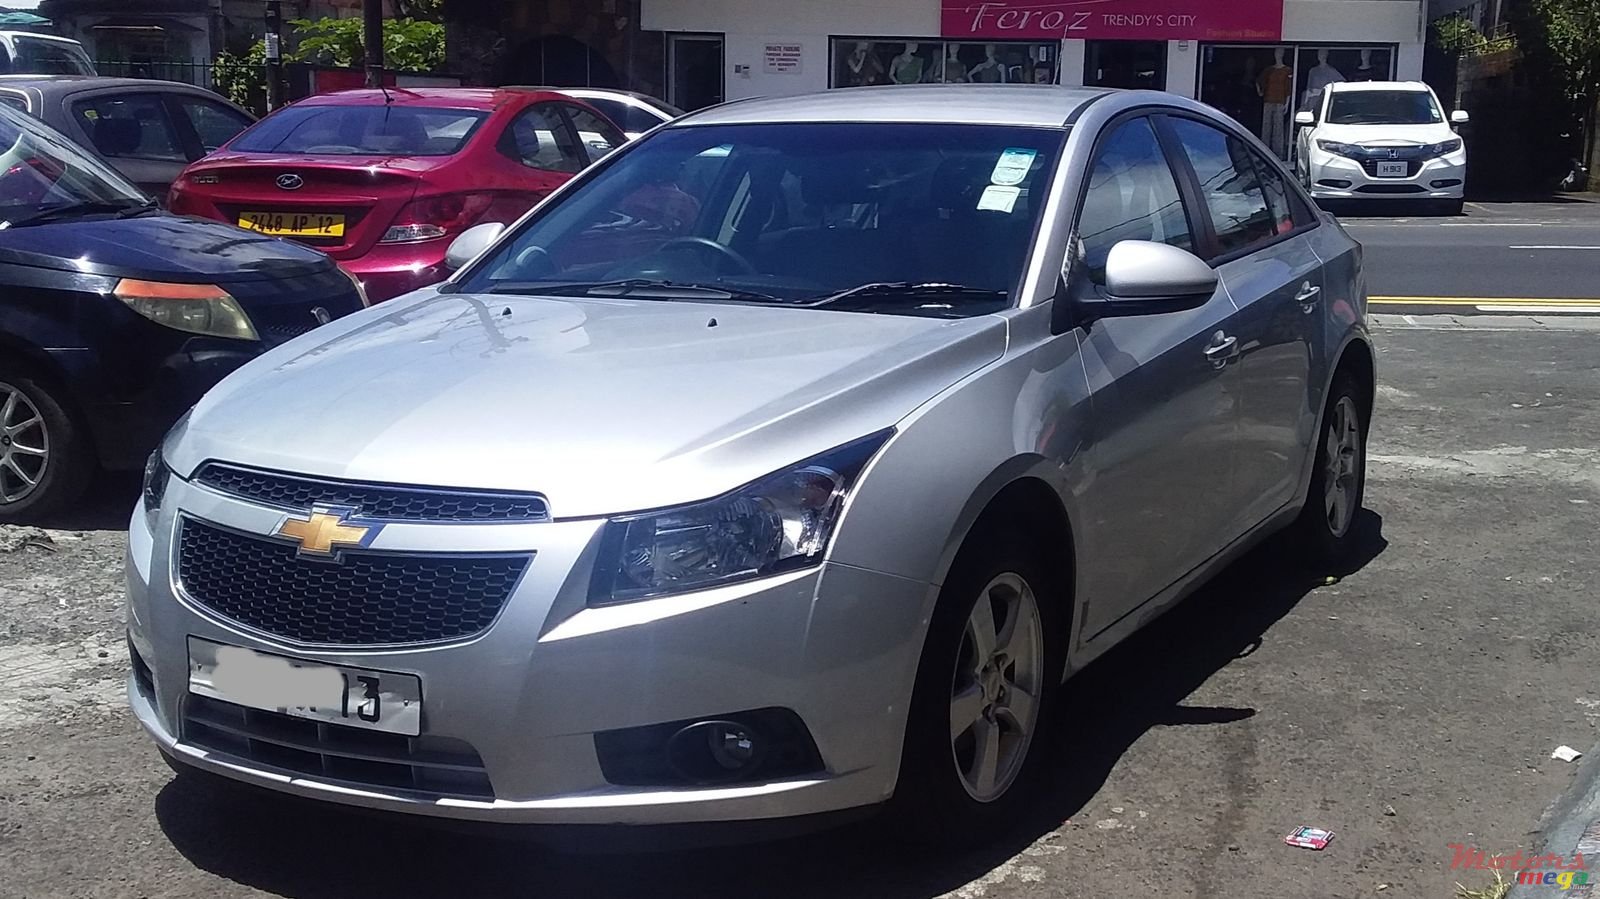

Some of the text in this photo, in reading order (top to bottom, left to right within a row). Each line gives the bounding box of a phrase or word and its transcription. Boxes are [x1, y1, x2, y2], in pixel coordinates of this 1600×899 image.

[965, 2, 1092, 32] Feroz
[1102, 14, 1197, 27] TRENDY'S CITY
[250, 213, 333, 233] 2448 AP 12
